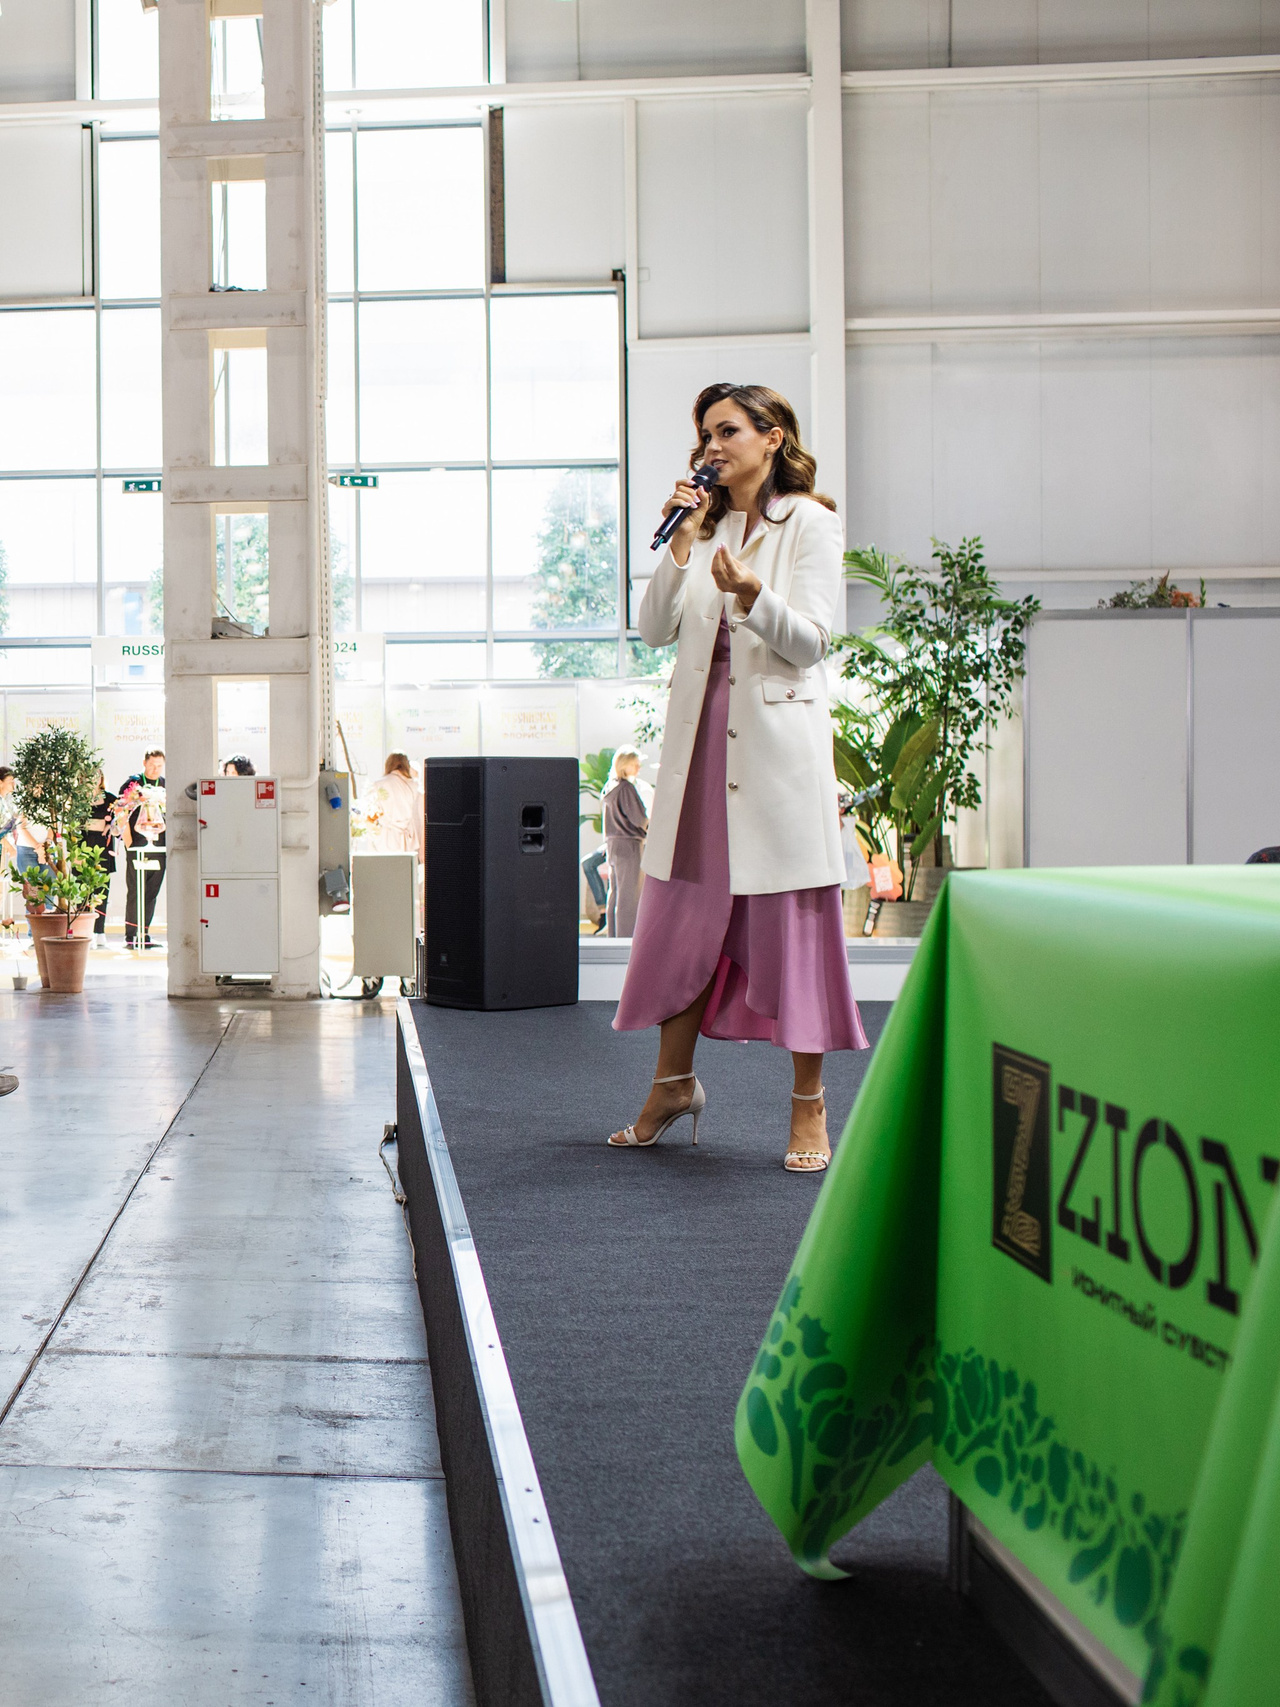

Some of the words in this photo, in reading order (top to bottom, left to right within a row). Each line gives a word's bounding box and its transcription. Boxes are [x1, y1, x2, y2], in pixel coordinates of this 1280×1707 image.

[122, 644, 164, 656] RUSSI
[333, 642, 357, 653] 024
[1162, 1321, 1232, 1373] СУБСТ
